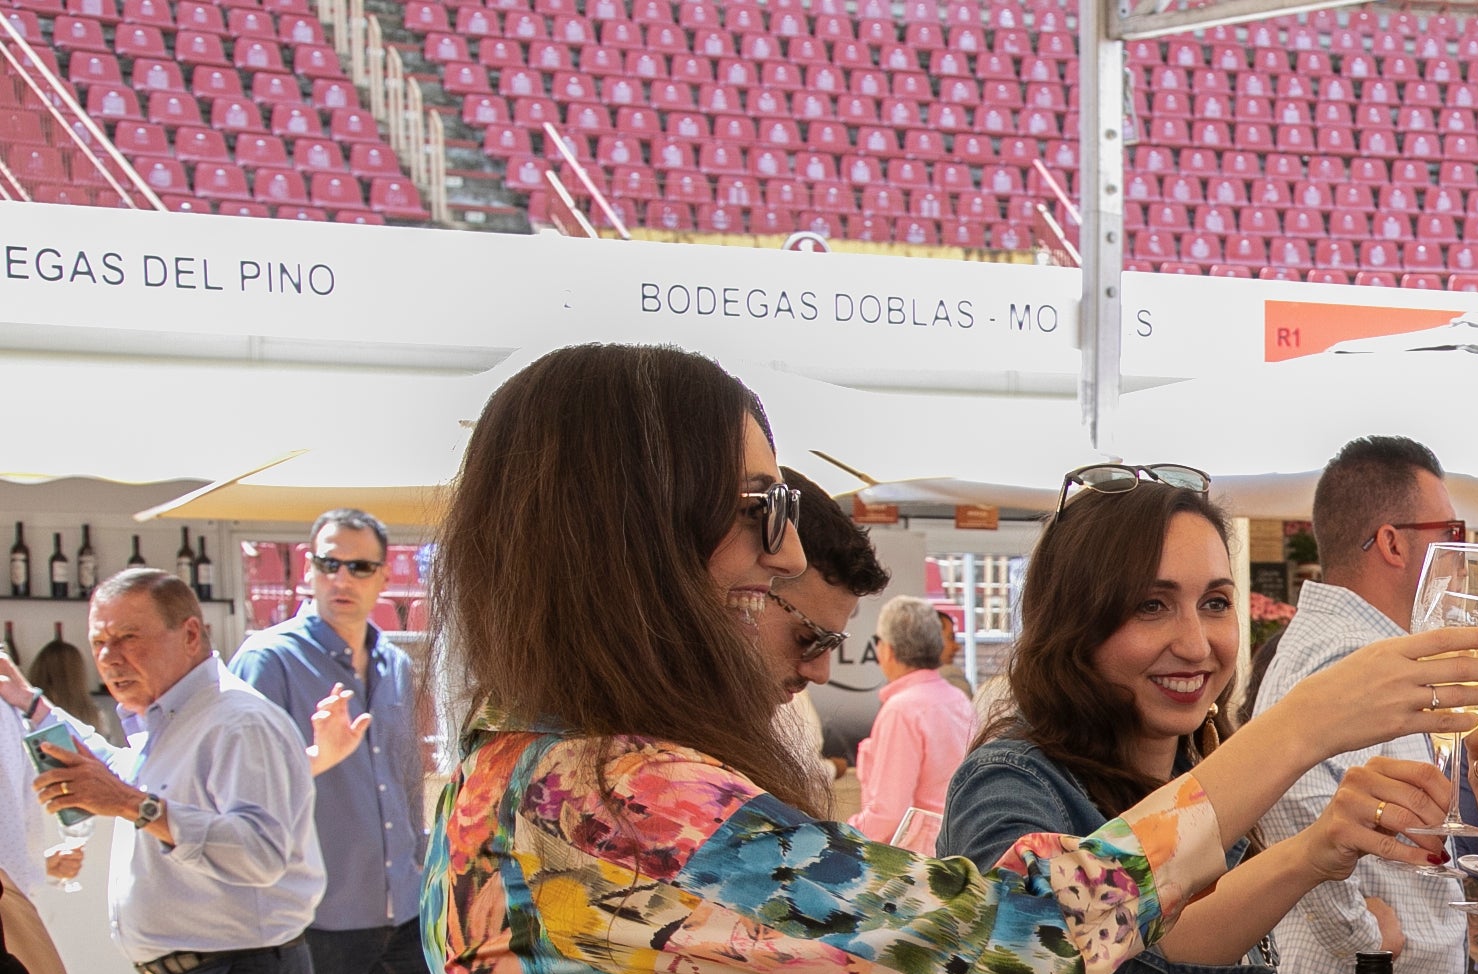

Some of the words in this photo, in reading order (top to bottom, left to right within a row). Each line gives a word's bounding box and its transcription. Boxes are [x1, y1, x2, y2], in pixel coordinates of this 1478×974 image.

[143, 254, 224, 291] DEL
[239, 260, 336, 296] PINO
[640, 282, 819, 321] BODEGAS
[834, 293, 975, 329] DOBLAS
[1276, 327, 1301, 348] R1
